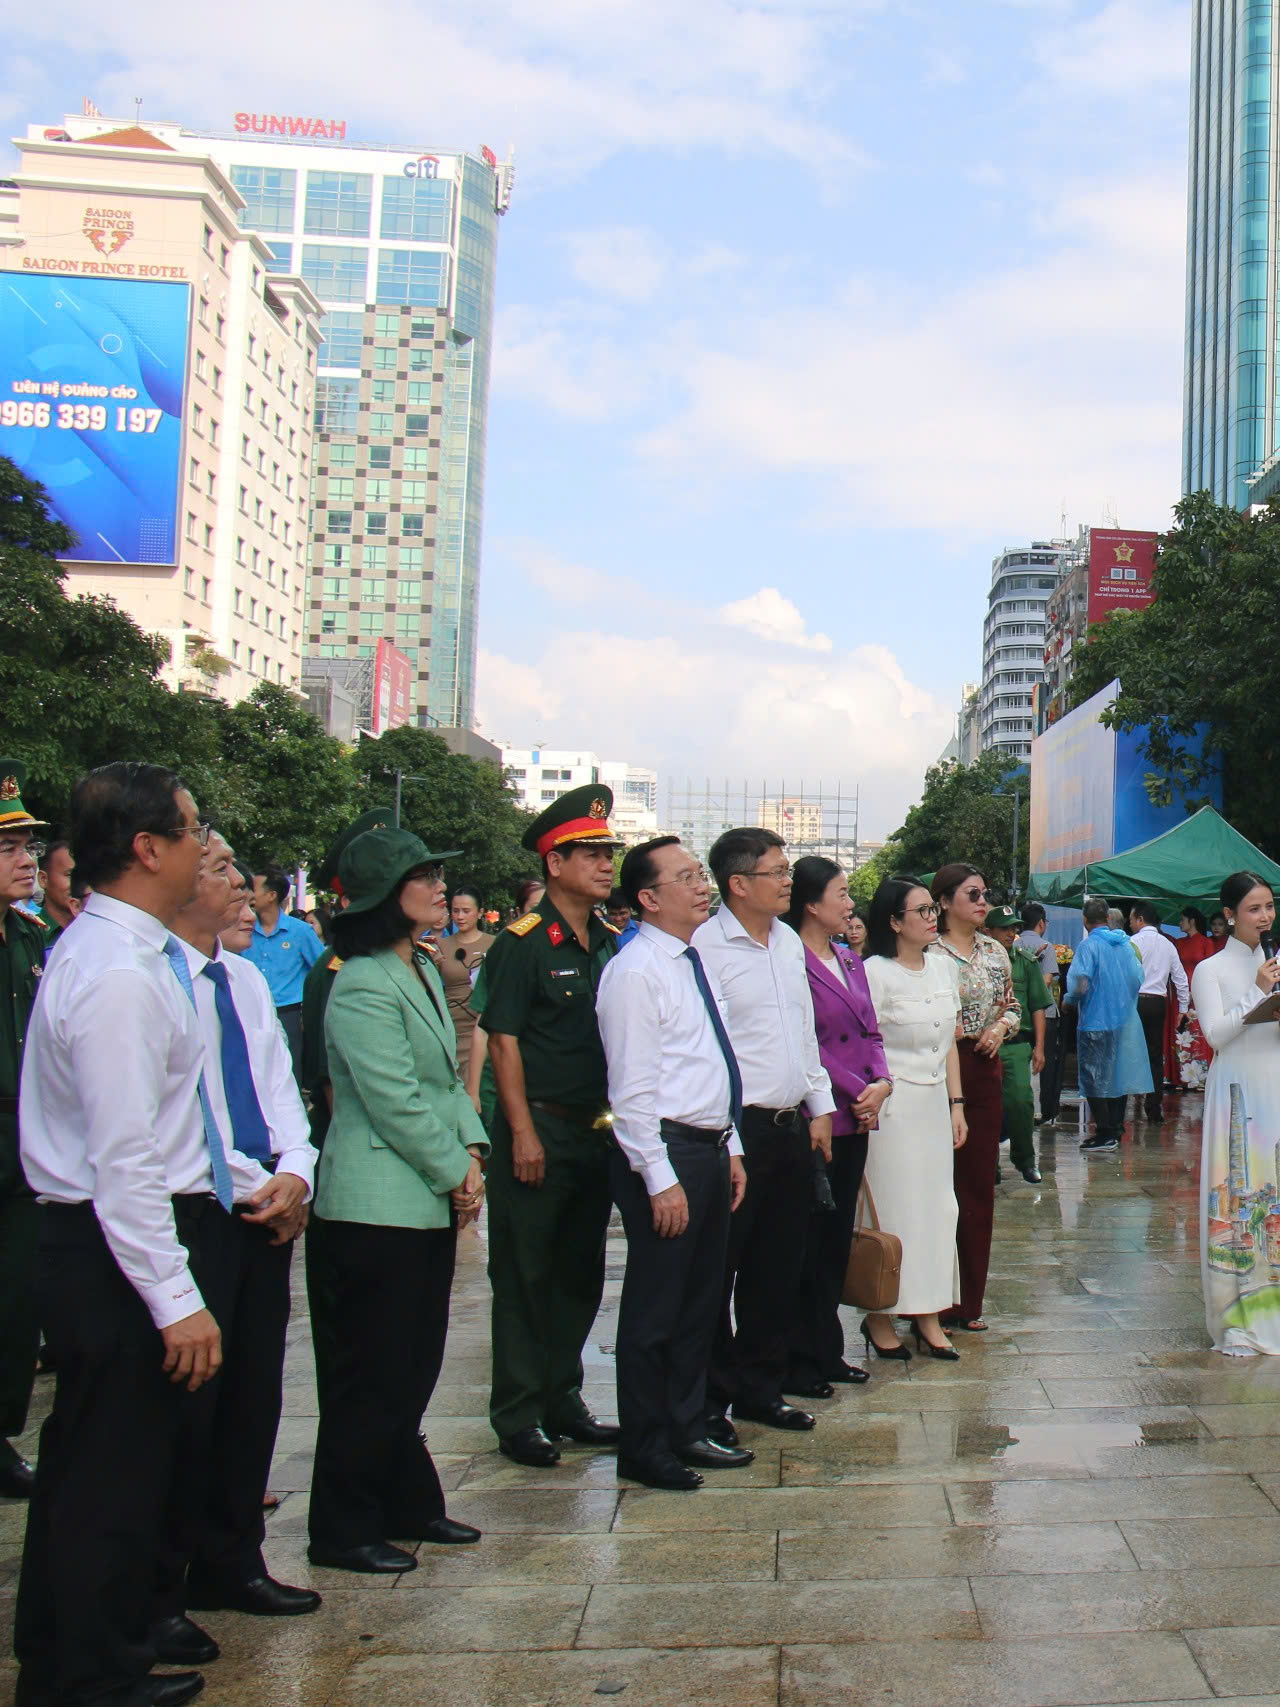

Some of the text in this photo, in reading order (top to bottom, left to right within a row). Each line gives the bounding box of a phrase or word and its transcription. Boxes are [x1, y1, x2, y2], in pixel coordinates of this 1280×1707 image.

[234, 112, 346, 139] SUNWAH
[403, 154, 440, 179] citi
[83, 217, 134, 230] PRINCE
[85, 207, 132, 219] SAIGON
[23, 257, 188, 278] SAIGON PRINCE HOTEL
[12, 378, 138, 399] LIÊN HỆ QUẢNG CÁO
[0, 400, 163, 433] 966 339 197
